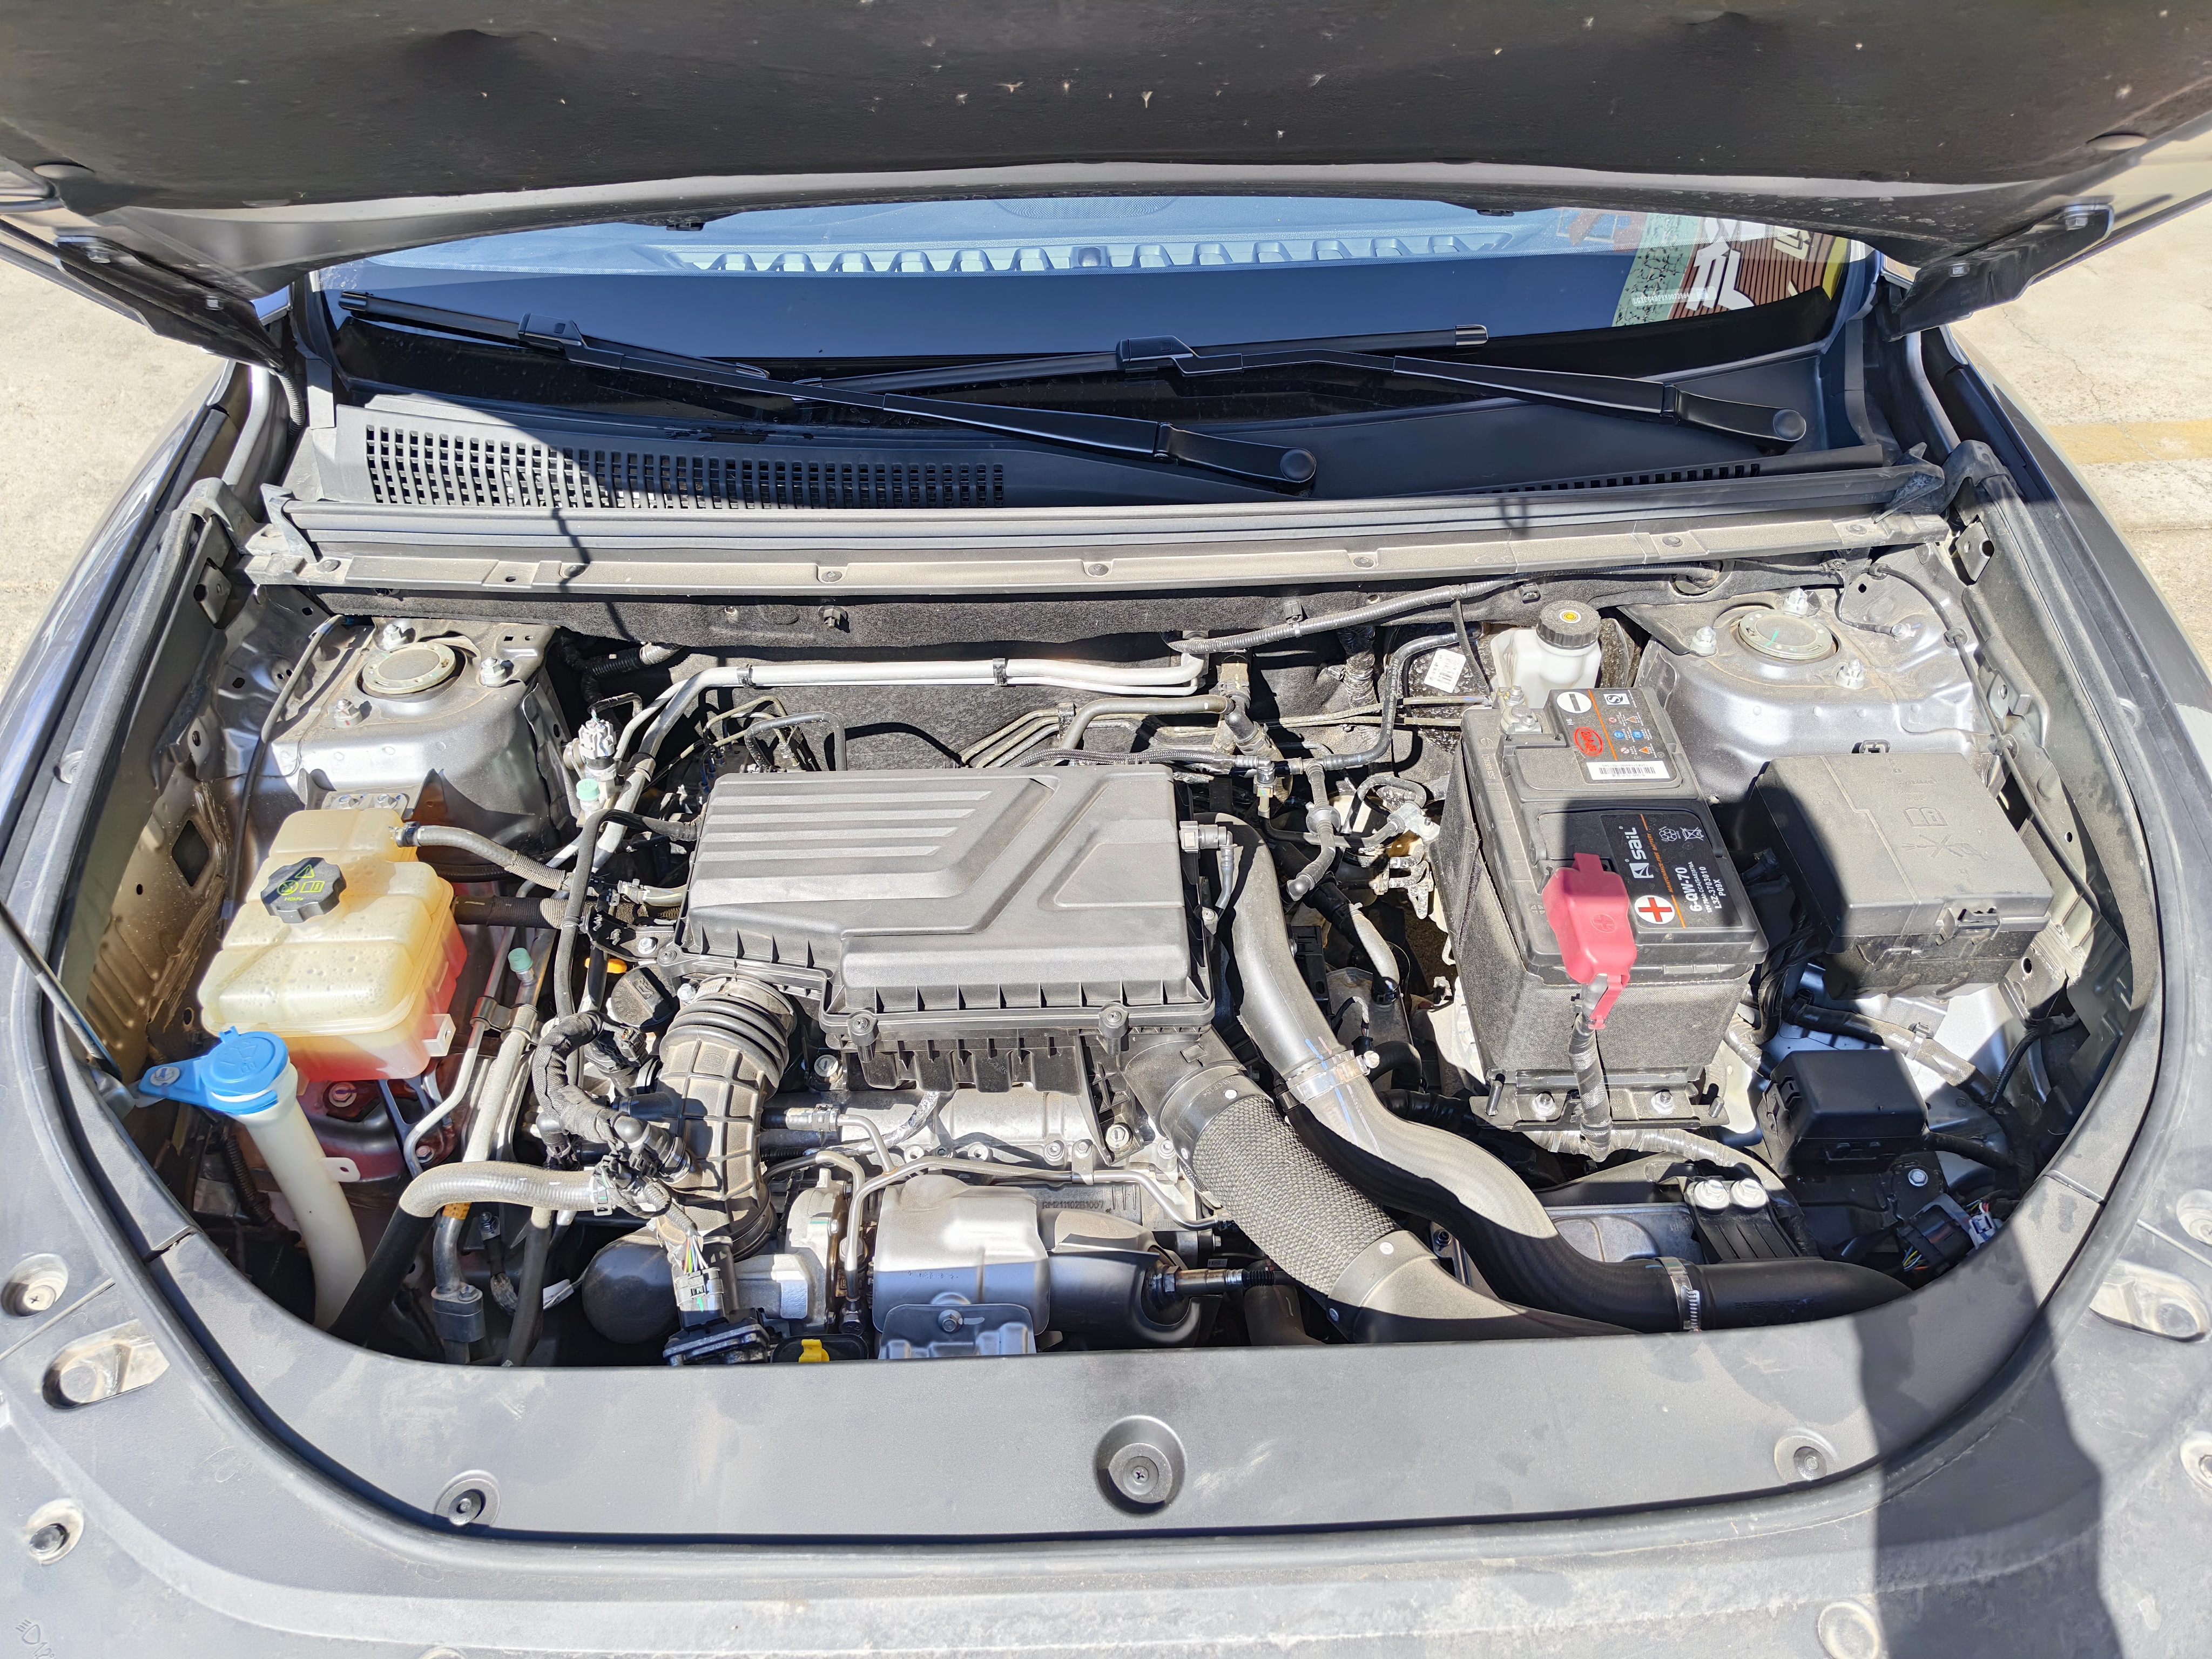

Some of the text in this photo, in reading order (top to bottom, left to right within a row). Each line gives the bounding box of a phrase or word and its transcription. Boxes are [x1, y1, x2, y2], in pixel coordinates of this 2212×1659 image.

[1580, 731, 1597, 752] BYD
[1647, 833, 1674, 893] MAINTENANCE-FREE BATTERY
[1675, 867, 1703, 912] 6-QW-70
[1698, 867, 1722, 908] L3Z-3703010
[1713, 879, 1726, 896] P09X
